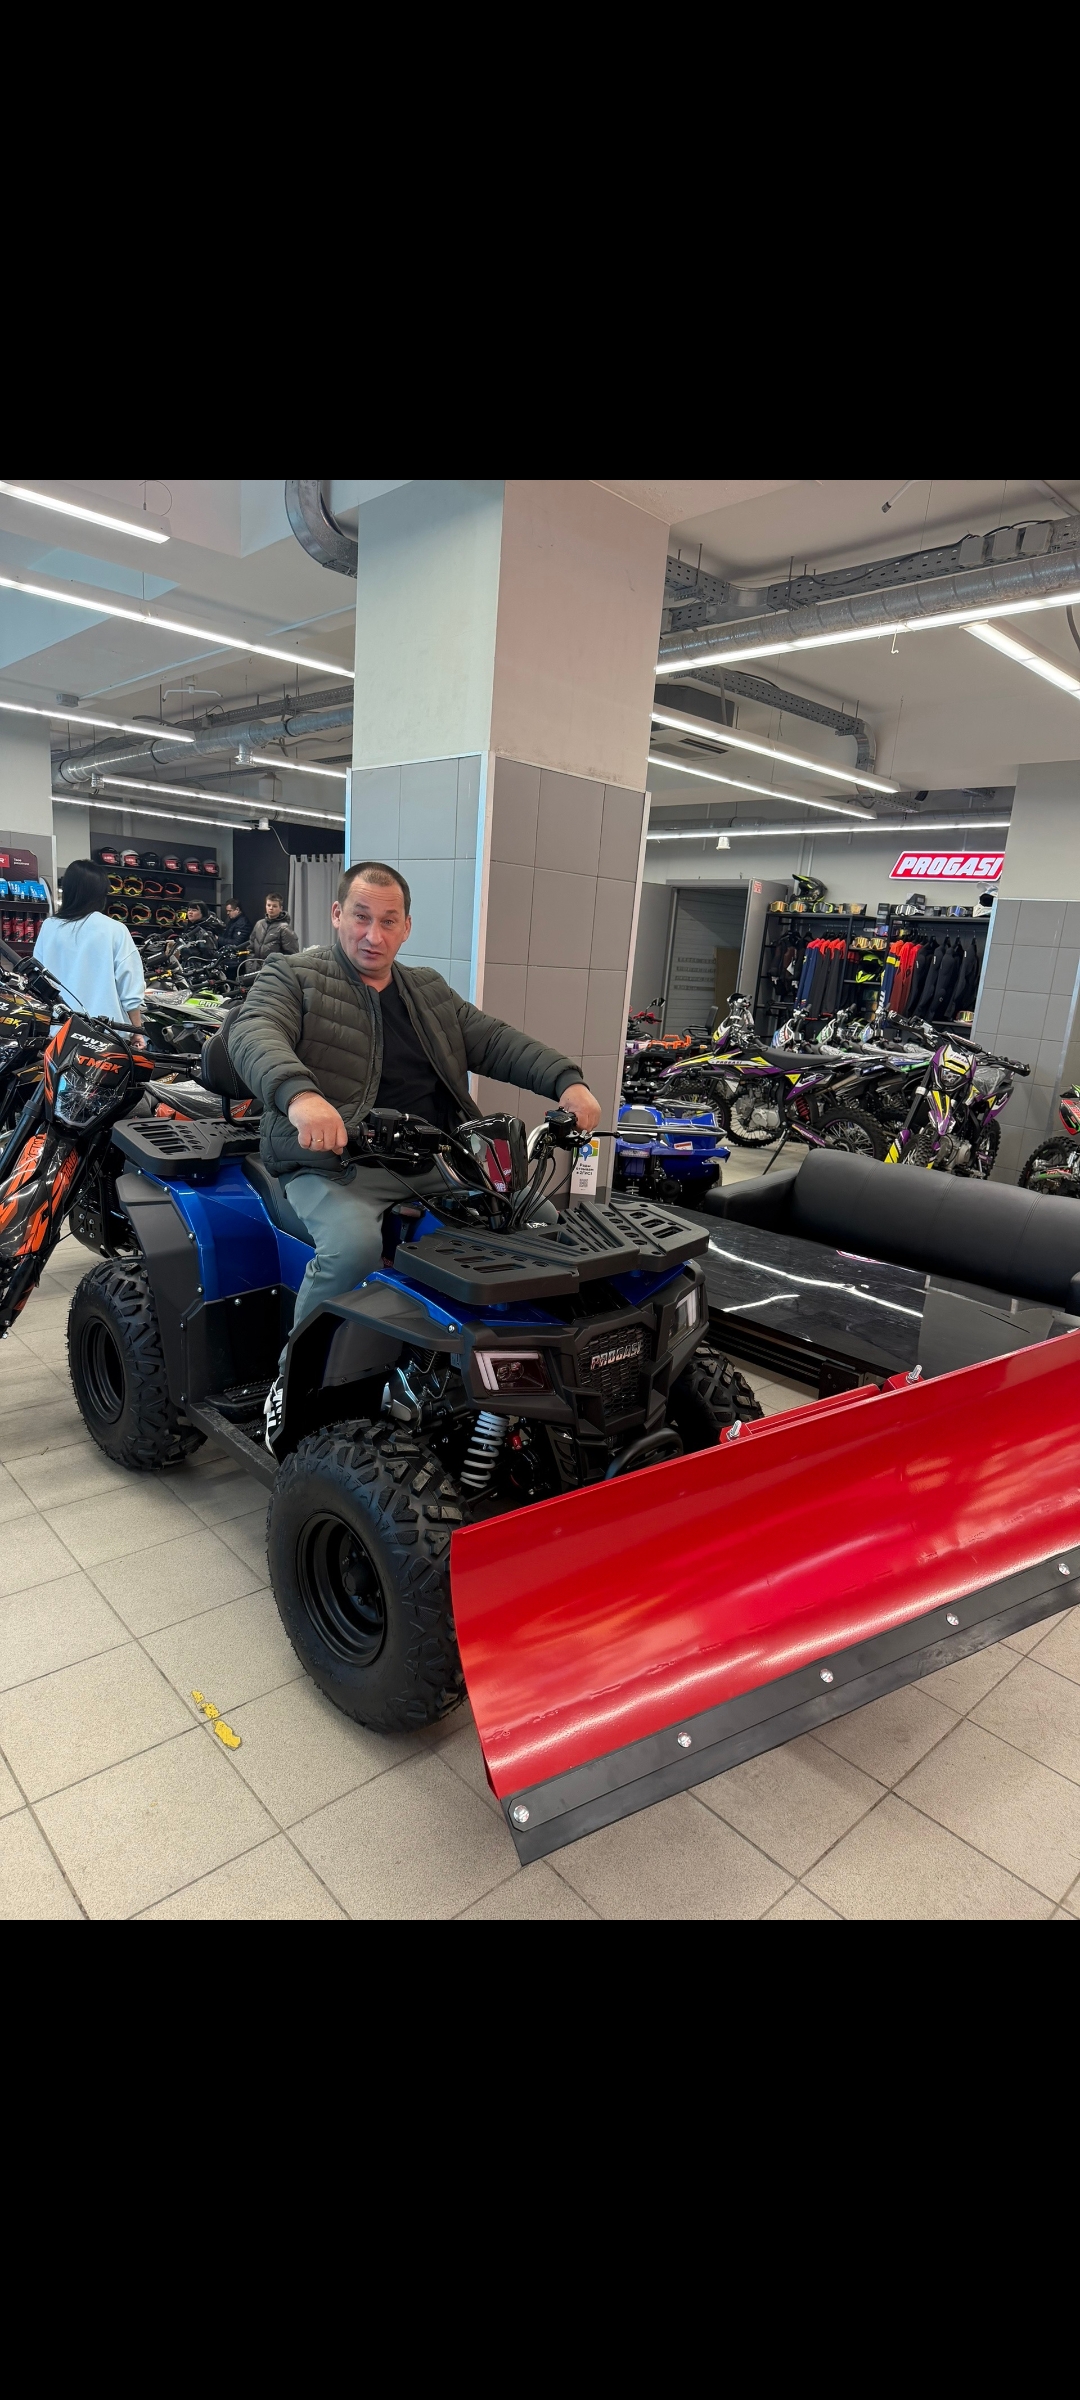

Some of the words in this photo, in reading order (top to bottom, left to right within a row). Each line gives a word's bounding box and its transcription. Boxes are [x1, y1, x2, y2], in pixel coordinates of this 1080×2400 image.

[896, 856, 1004, 876] PROGASI
[200, 1000, 221, 1009] PRO
[70, 1032, 107, 1047] ENVY
[78, 1055, 123, 1074] TMBK
[591, 1341, 641, 1370] PROGASI
